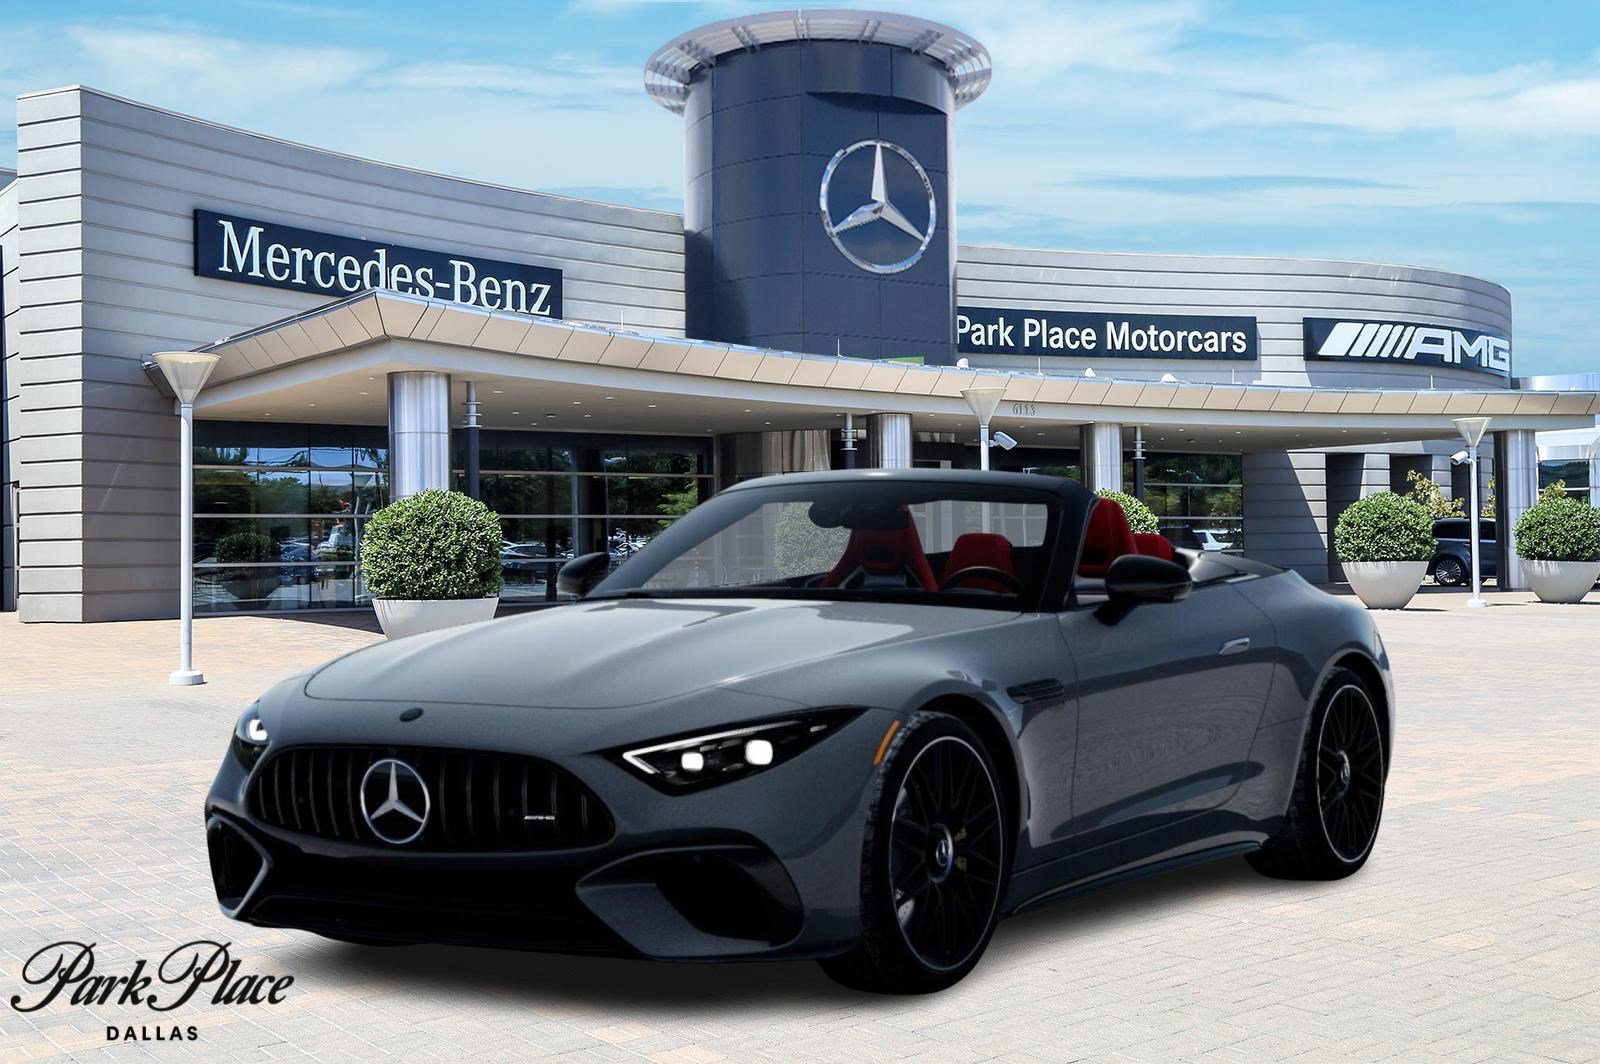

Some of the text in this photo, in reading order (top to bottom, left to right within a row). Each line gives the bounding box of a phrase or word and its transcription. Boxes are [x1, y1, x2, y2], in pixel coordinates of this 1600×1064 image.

[218, 219, 552, 317] Mercedes-Benz
[957, 315, 1248, 353] Park Place Motorcars
[1012, 402, 1036, 416] 6113
